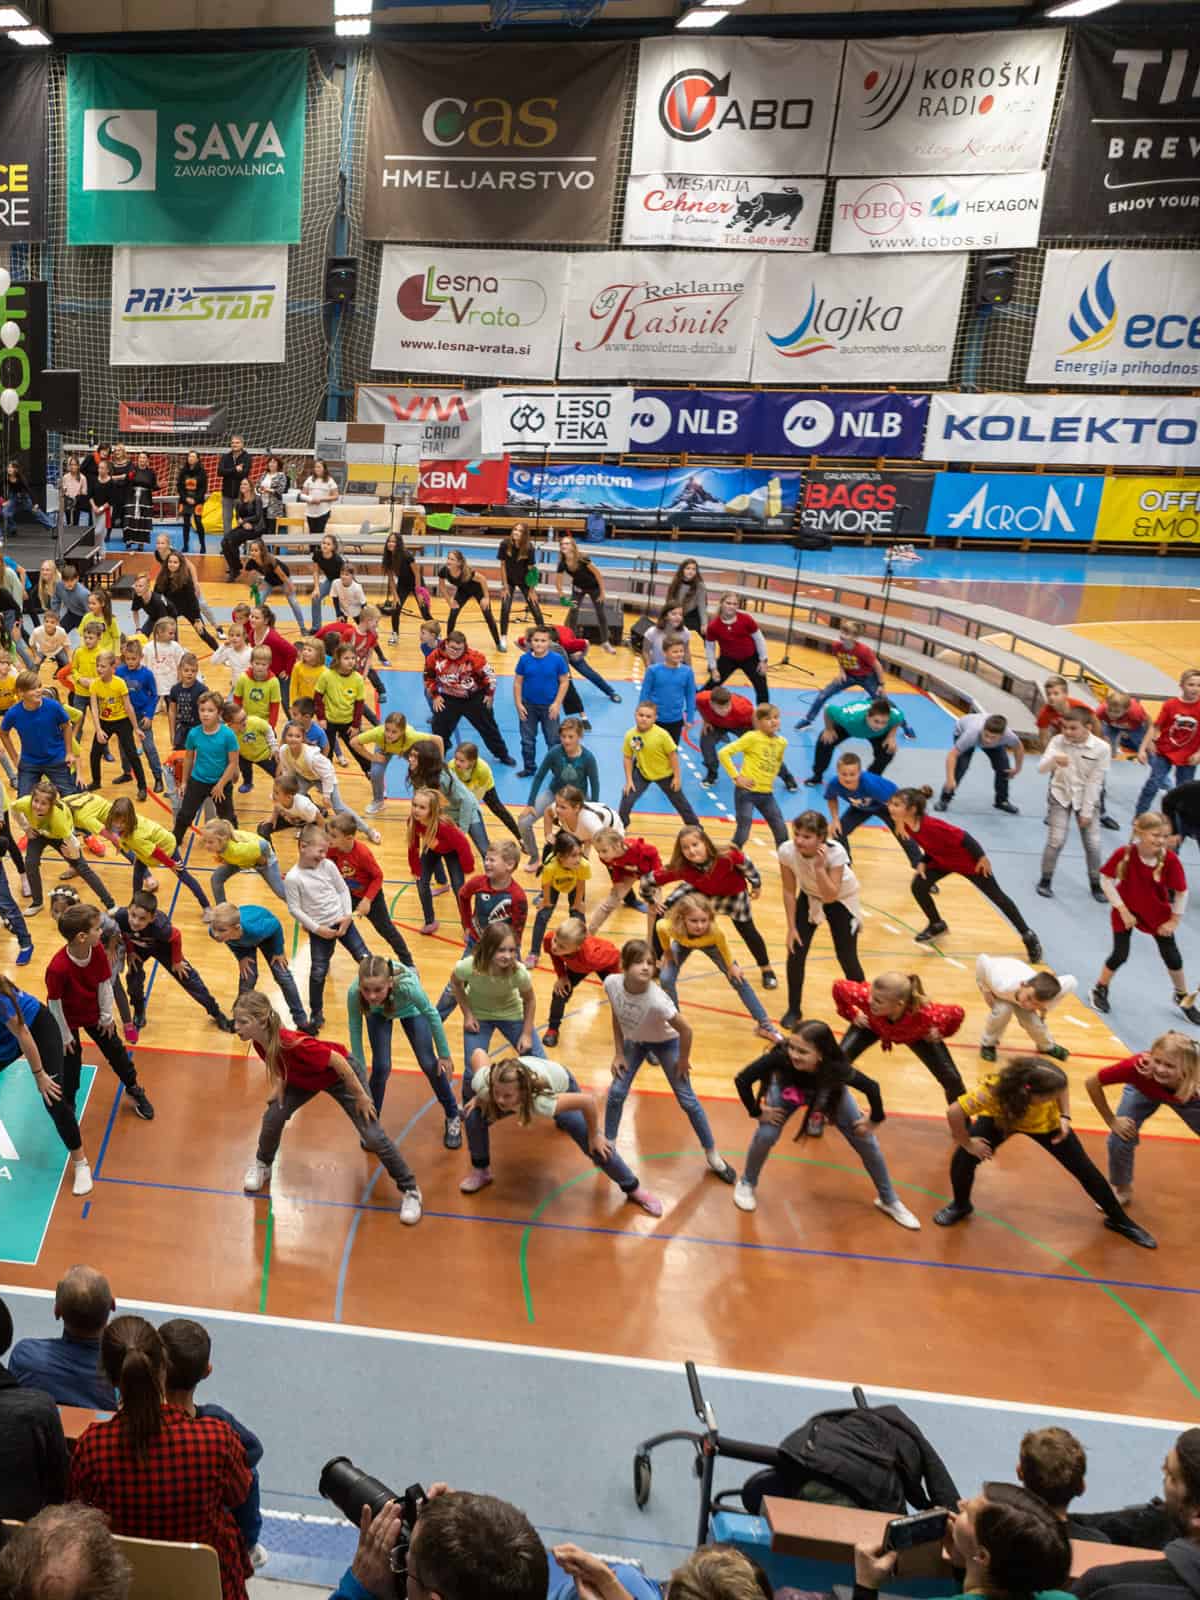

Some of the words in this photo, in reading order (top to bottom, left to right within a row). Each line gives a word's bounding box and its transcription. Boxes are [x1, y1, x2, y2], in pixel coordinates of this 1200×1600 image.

[922, 62, 1041, 90] KOROŠKI
[1112, 49, 1200, 104] TI
[174, 120, 286, 161] SAVA
[174, 163, 285, 177] ZAVAROVALNICA
[381, 169, 595, 190] HMELJARSTVO
[665, 177, 750, 193] MESARIJA
[643, 190, 735, 214] Cehner
[965, 198, 1039, 213] HEXAGON
[1109, 197, 1155, 214] ENJOY
[1160, 196, 1200, 208] YOUR
[869, 232, 999, 248] www.tobos.si
[425, 265, 499, 302] Lesna
[645, 281, 744, 299] Reklame
[450, 297, 520, 327] Vrata
[813, 297, 903, 341] lajka
[400, 339, 531, 355] www.lesna-vrata.si
[1055, 360, 1118, 376] Energija
[1122, 361, 1200, 376] prihodnos
[555, 399, 611, 419] LESO
[555, 422, 608, 440] TEKA
[677, 409, 738, 435] NLB
[840, 412, 902, 438] NLB
[943, 415, 1199, 445] KOLEKTO
[804, 483, 897, 511] BAGS
